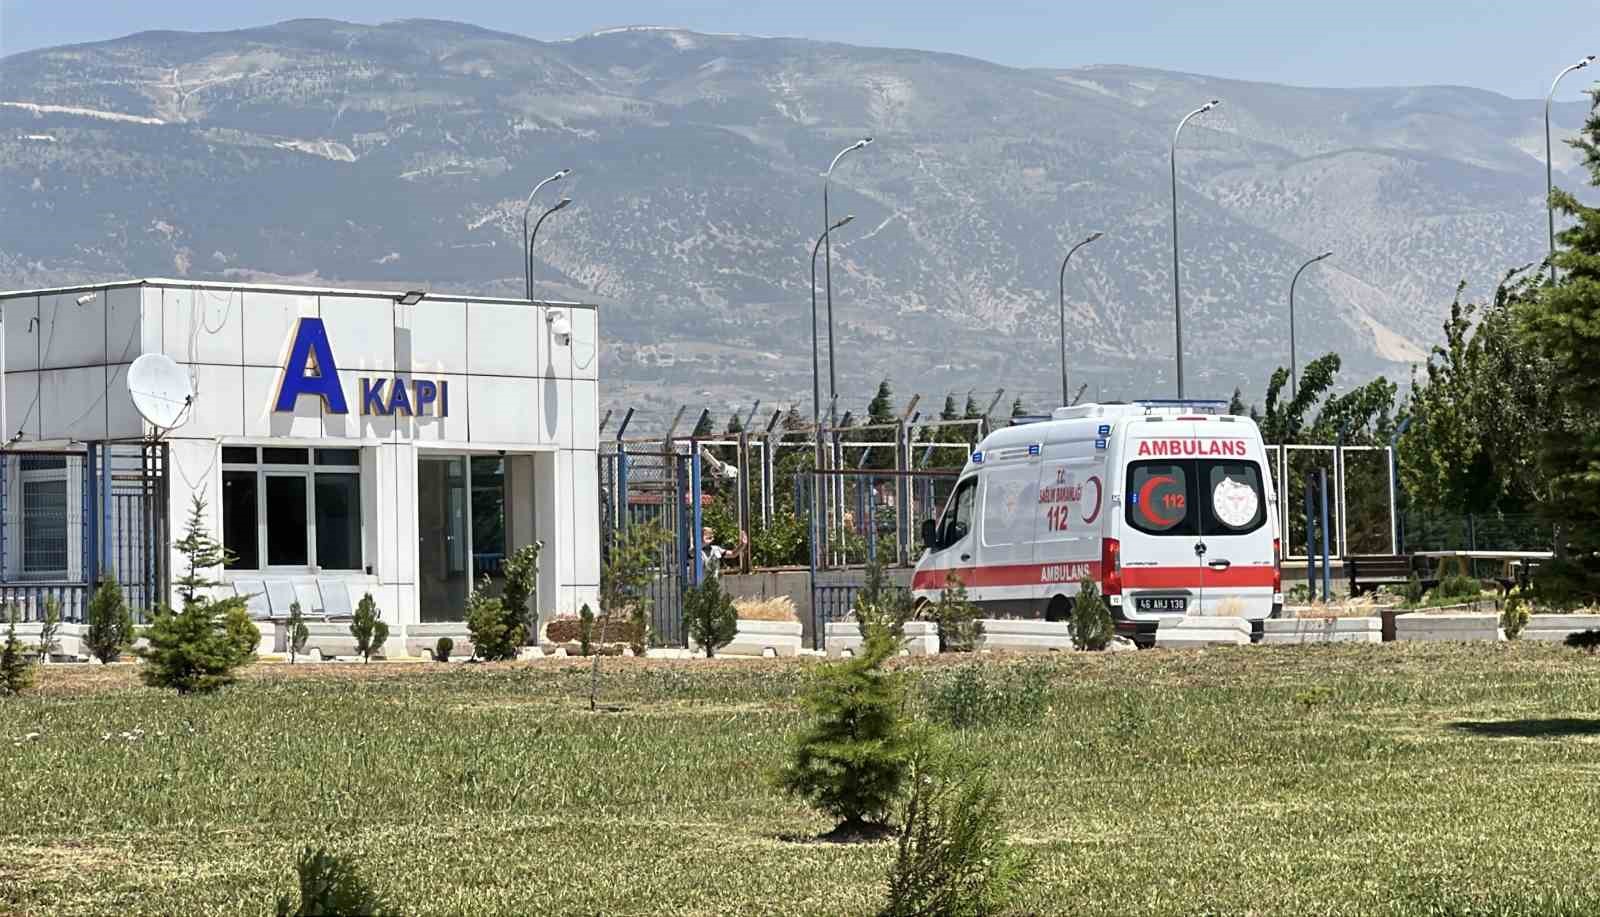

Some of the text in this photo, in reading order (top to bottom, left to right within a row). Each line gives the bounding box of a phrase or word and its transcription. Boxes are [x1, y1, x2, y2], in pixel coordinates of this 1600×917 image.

[274, 317, 449, 418] A KAPI
[1138, 439, 1247, 456] AMBULANS
[1162, 494, 1185, 509] 112
[1047, 505, 1069, 532] 112
[1040, 563, 1091, 583] AMBULANS
[1140, 599, 1151, 609] 46
[1153, 599, 1168, 609] AHJ
